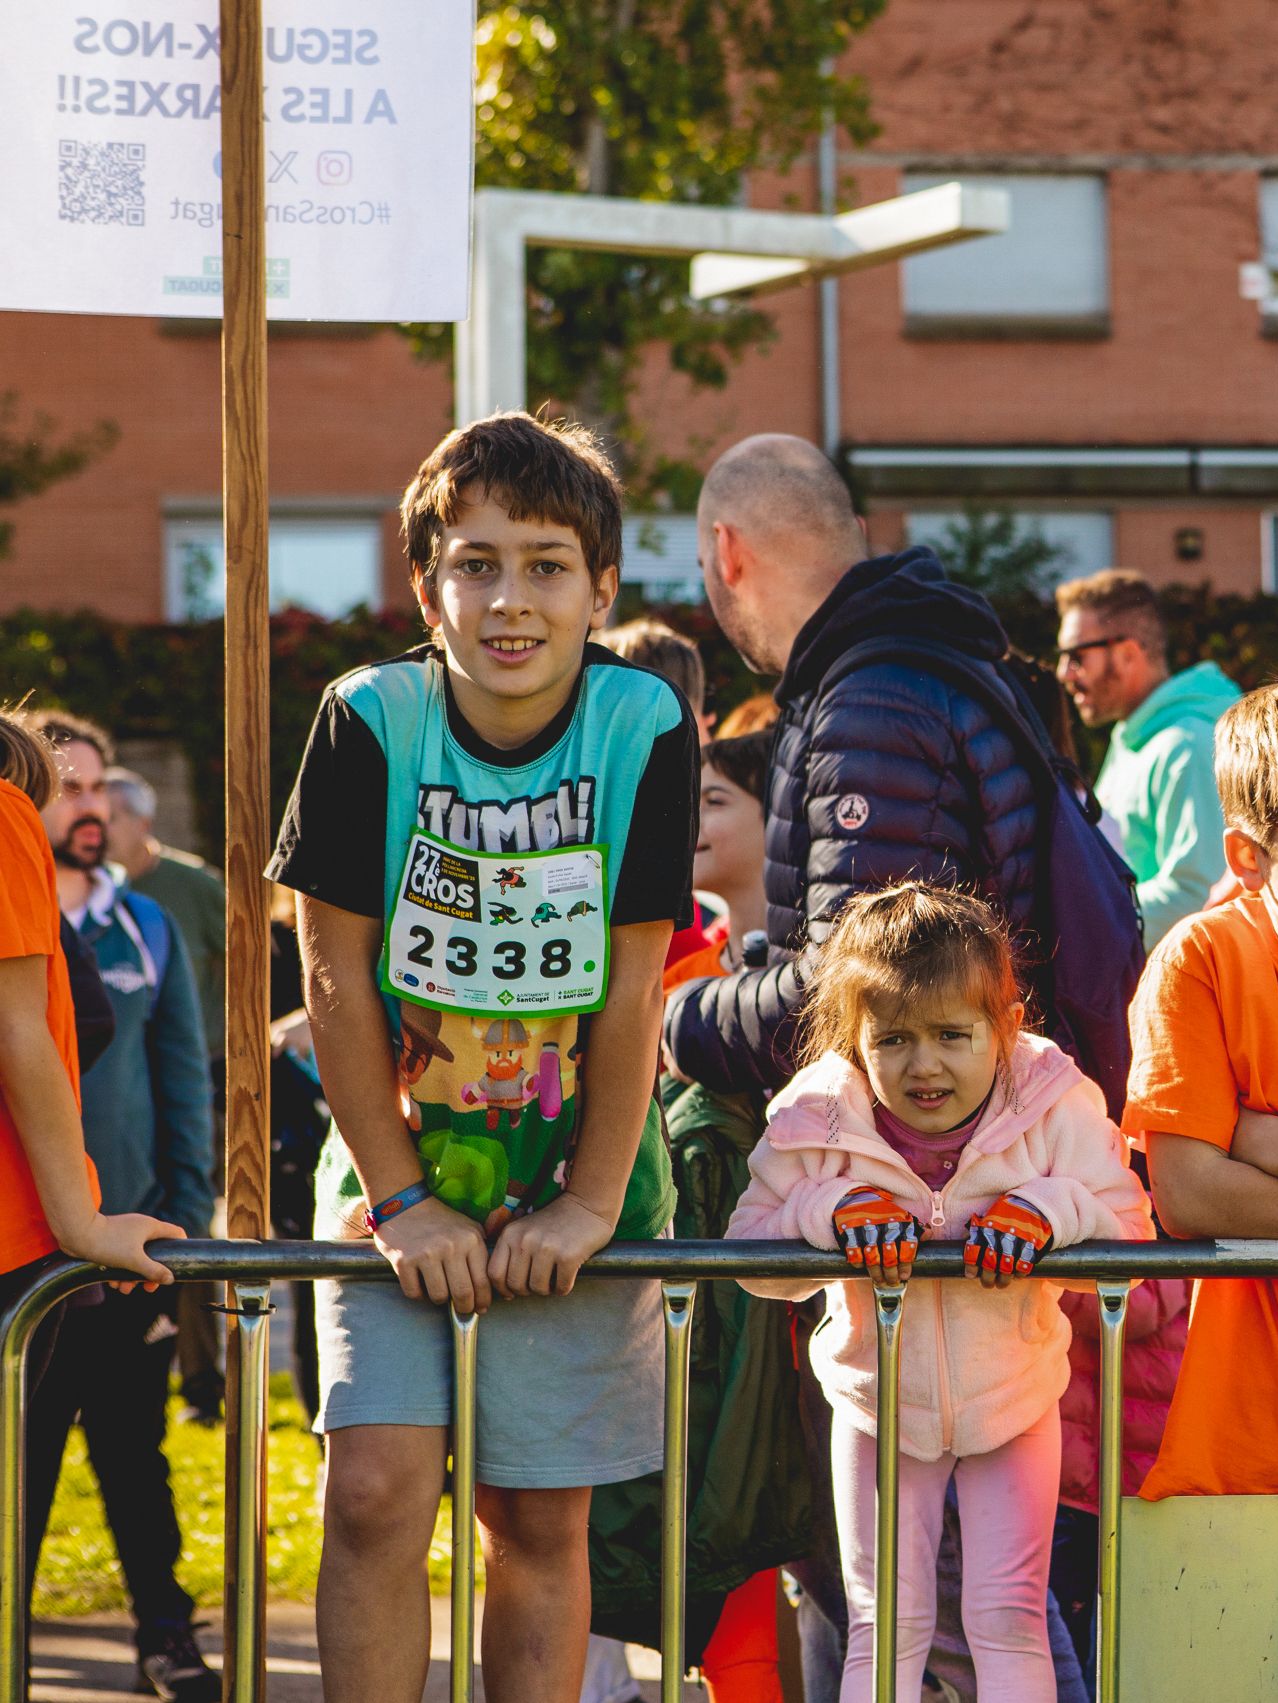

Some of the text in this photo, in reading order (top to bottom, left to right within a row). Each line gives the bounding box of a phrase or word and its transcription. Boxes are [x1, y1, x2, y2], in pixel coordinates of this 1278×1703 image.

[408, 892, 474, 918] Ciutat de Sant Cugat
[411, 866, 474, 908] CROS
[407, 925, 572, 980] 2338
